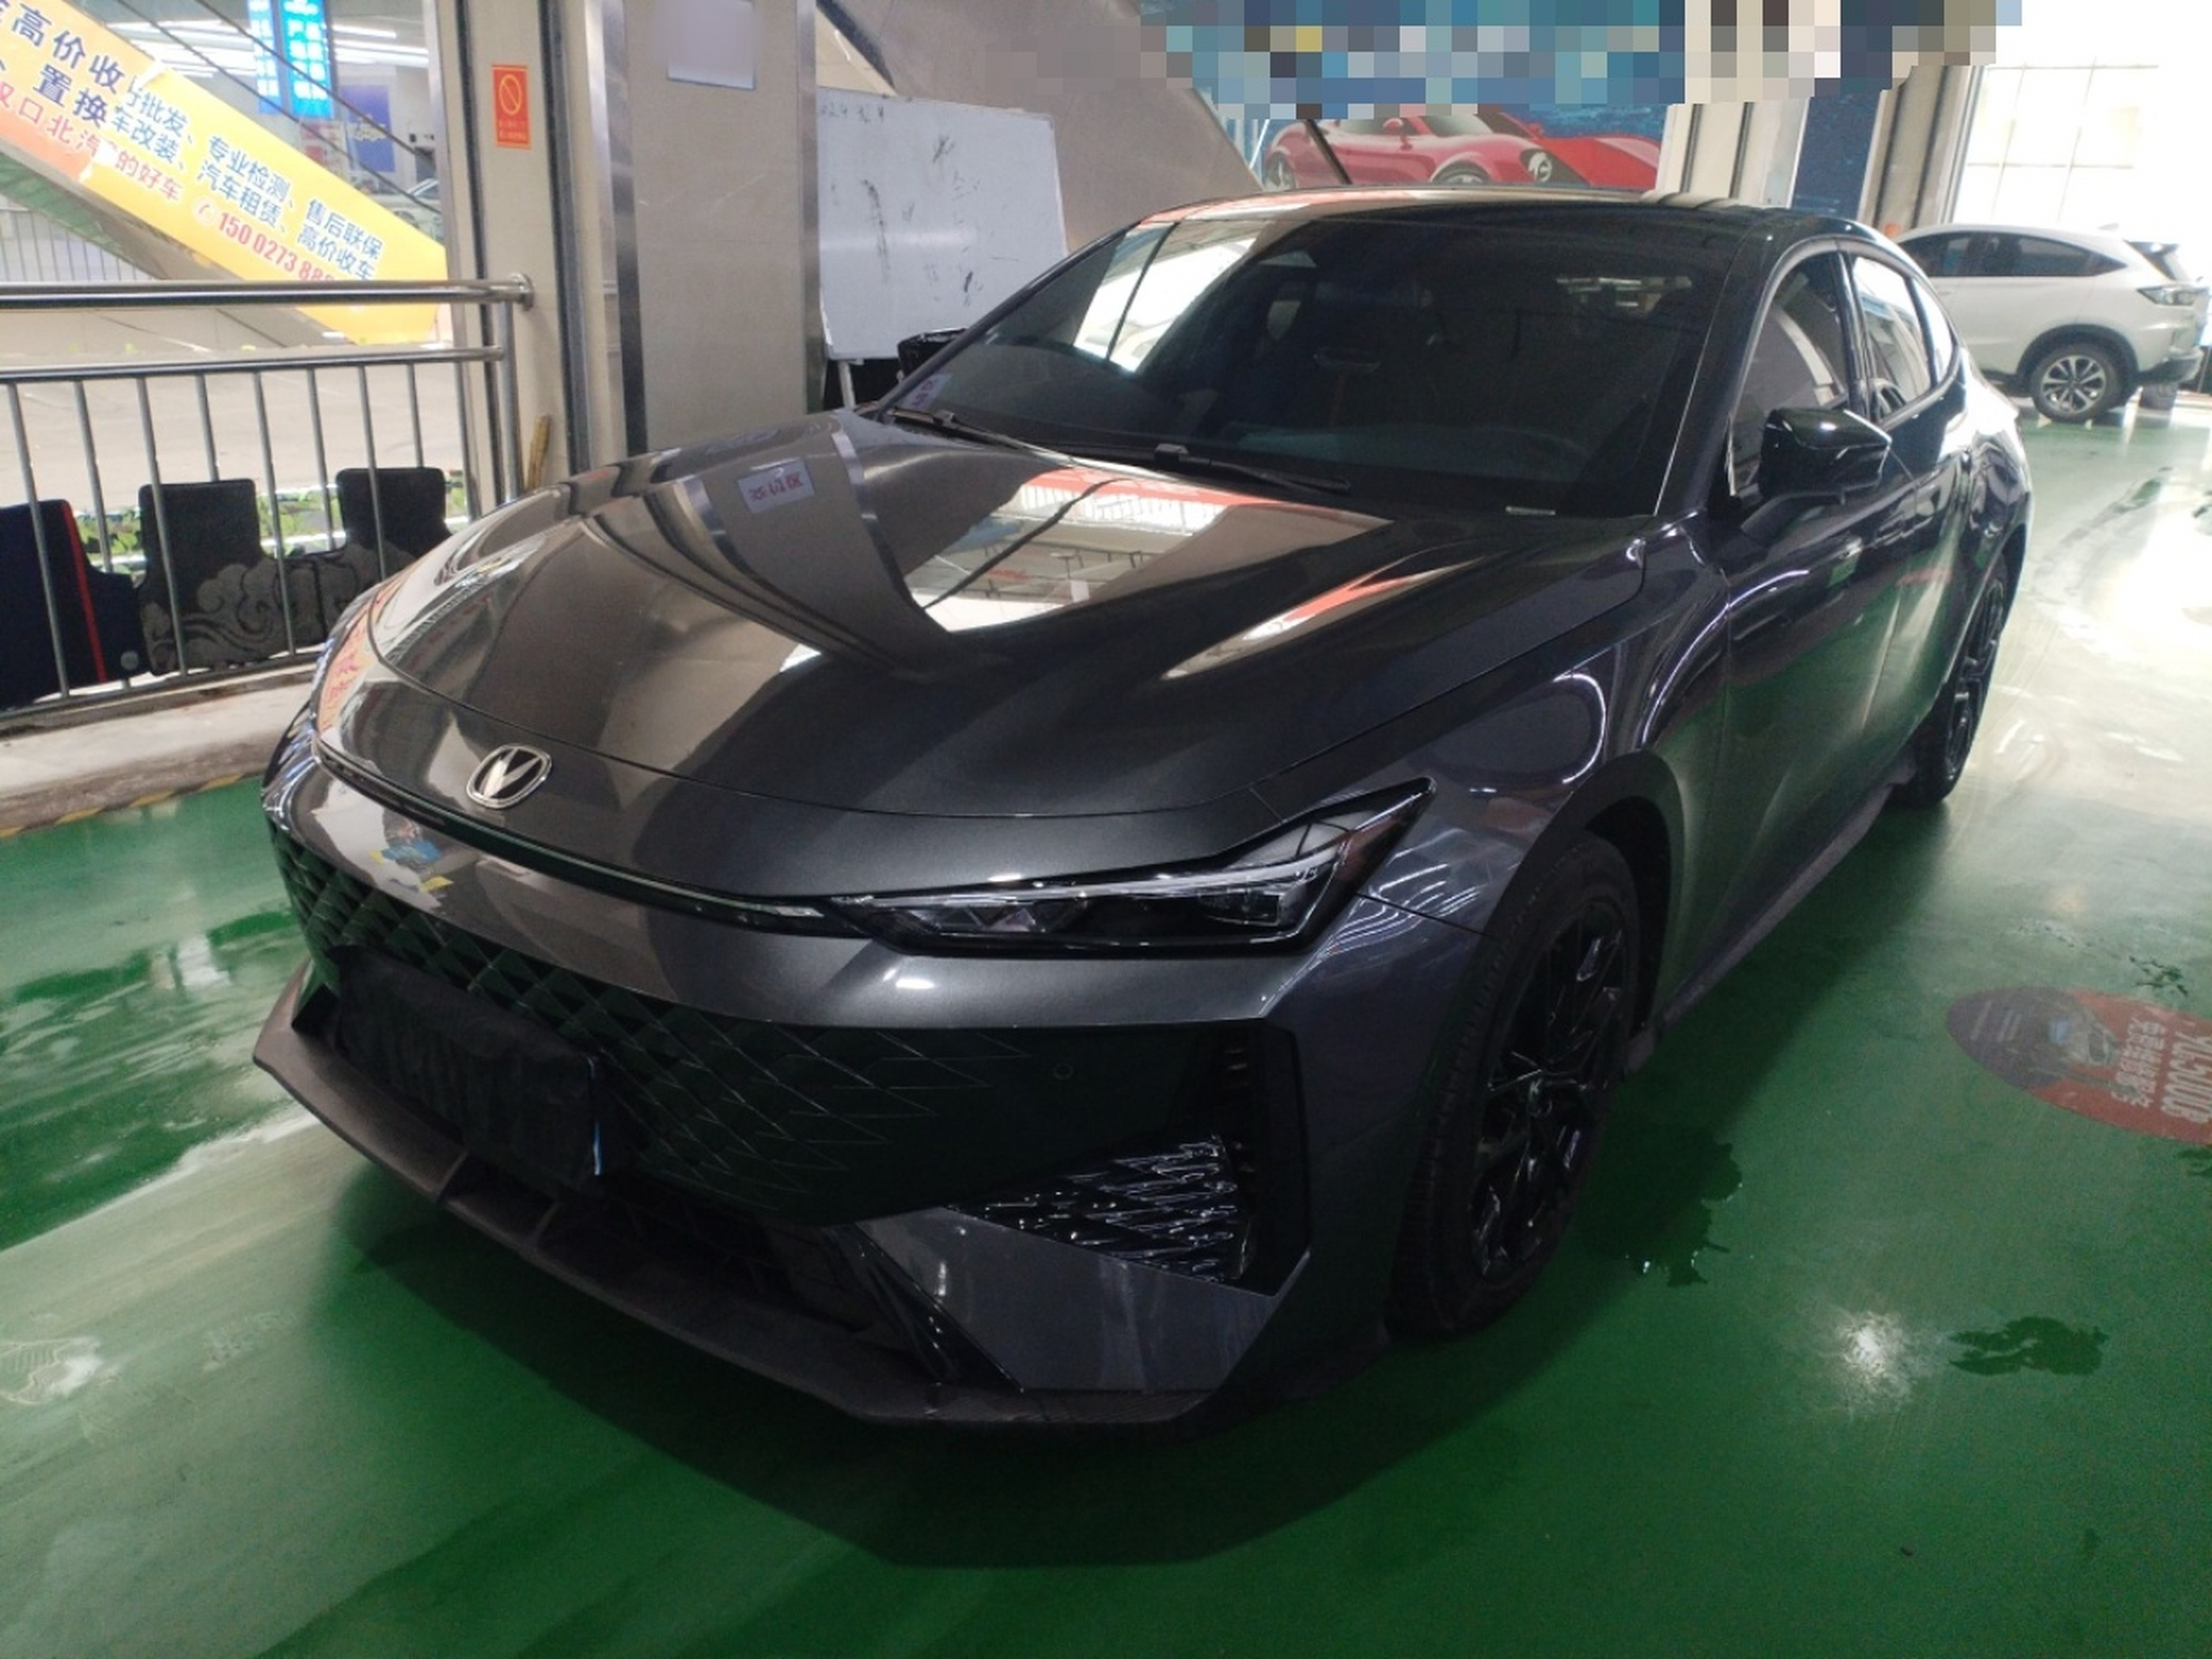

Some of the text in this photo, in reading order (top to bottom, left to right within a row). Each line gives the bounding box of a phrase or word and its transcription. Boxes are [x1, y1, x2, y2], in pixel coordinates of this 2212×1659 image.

[105, 140, 182, 200] 的好车
[218, 212, 252, 245] 150
[253, 233, 298, 272] 0273
